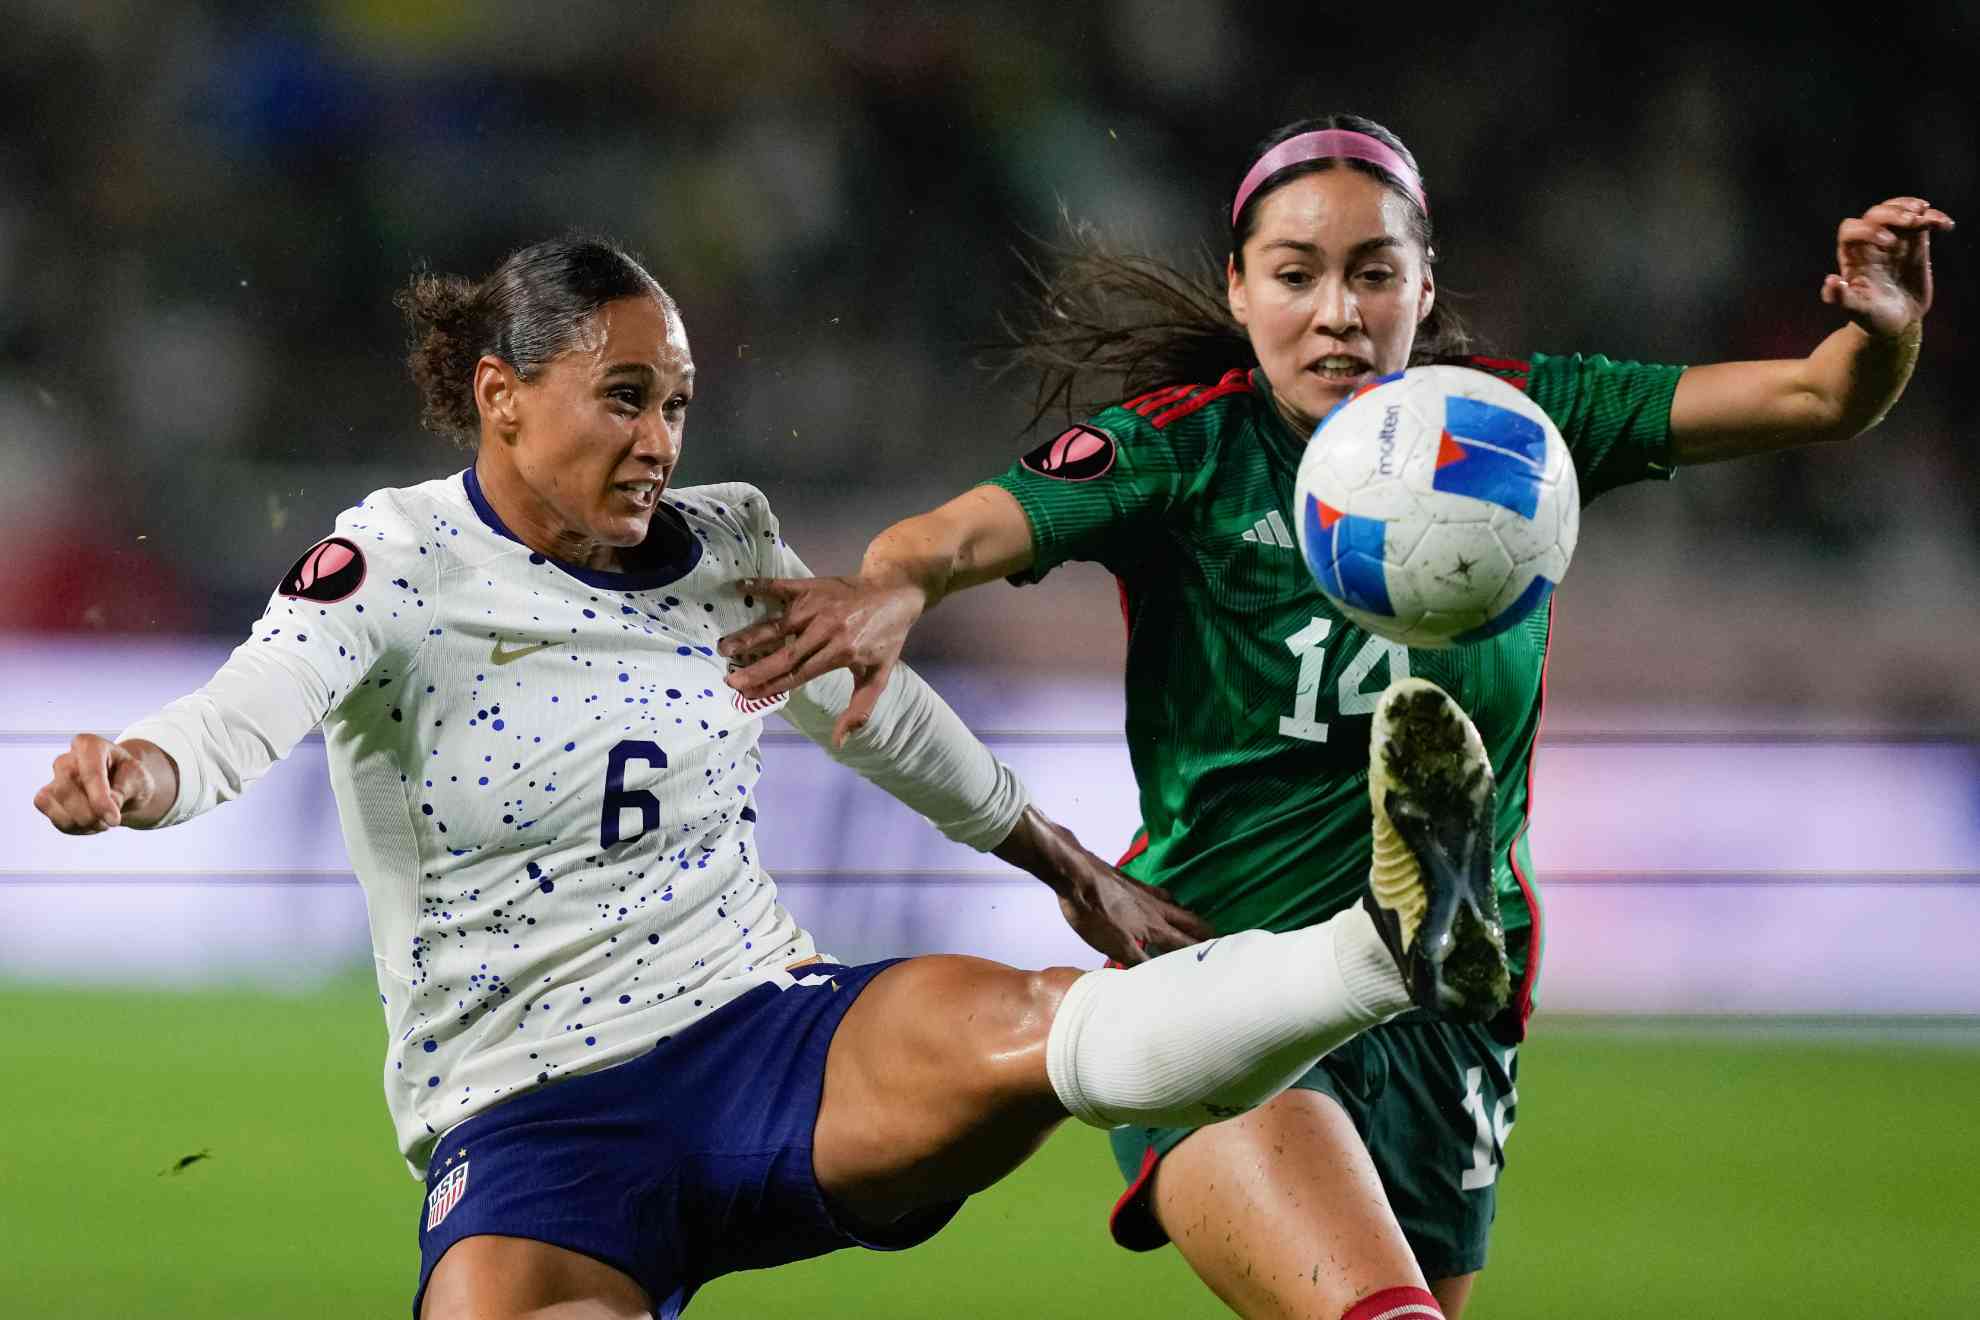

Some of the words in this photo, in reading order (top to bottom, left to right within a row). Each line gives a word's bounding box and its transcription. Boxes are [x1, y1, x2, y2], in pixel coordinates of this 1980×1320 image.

[1379, 405, 1401, 475] molten
[1279, 617, 1411, 743] 14
[600, 739, 668, 850] 6
[430, 1165, 466, 1206] USA
